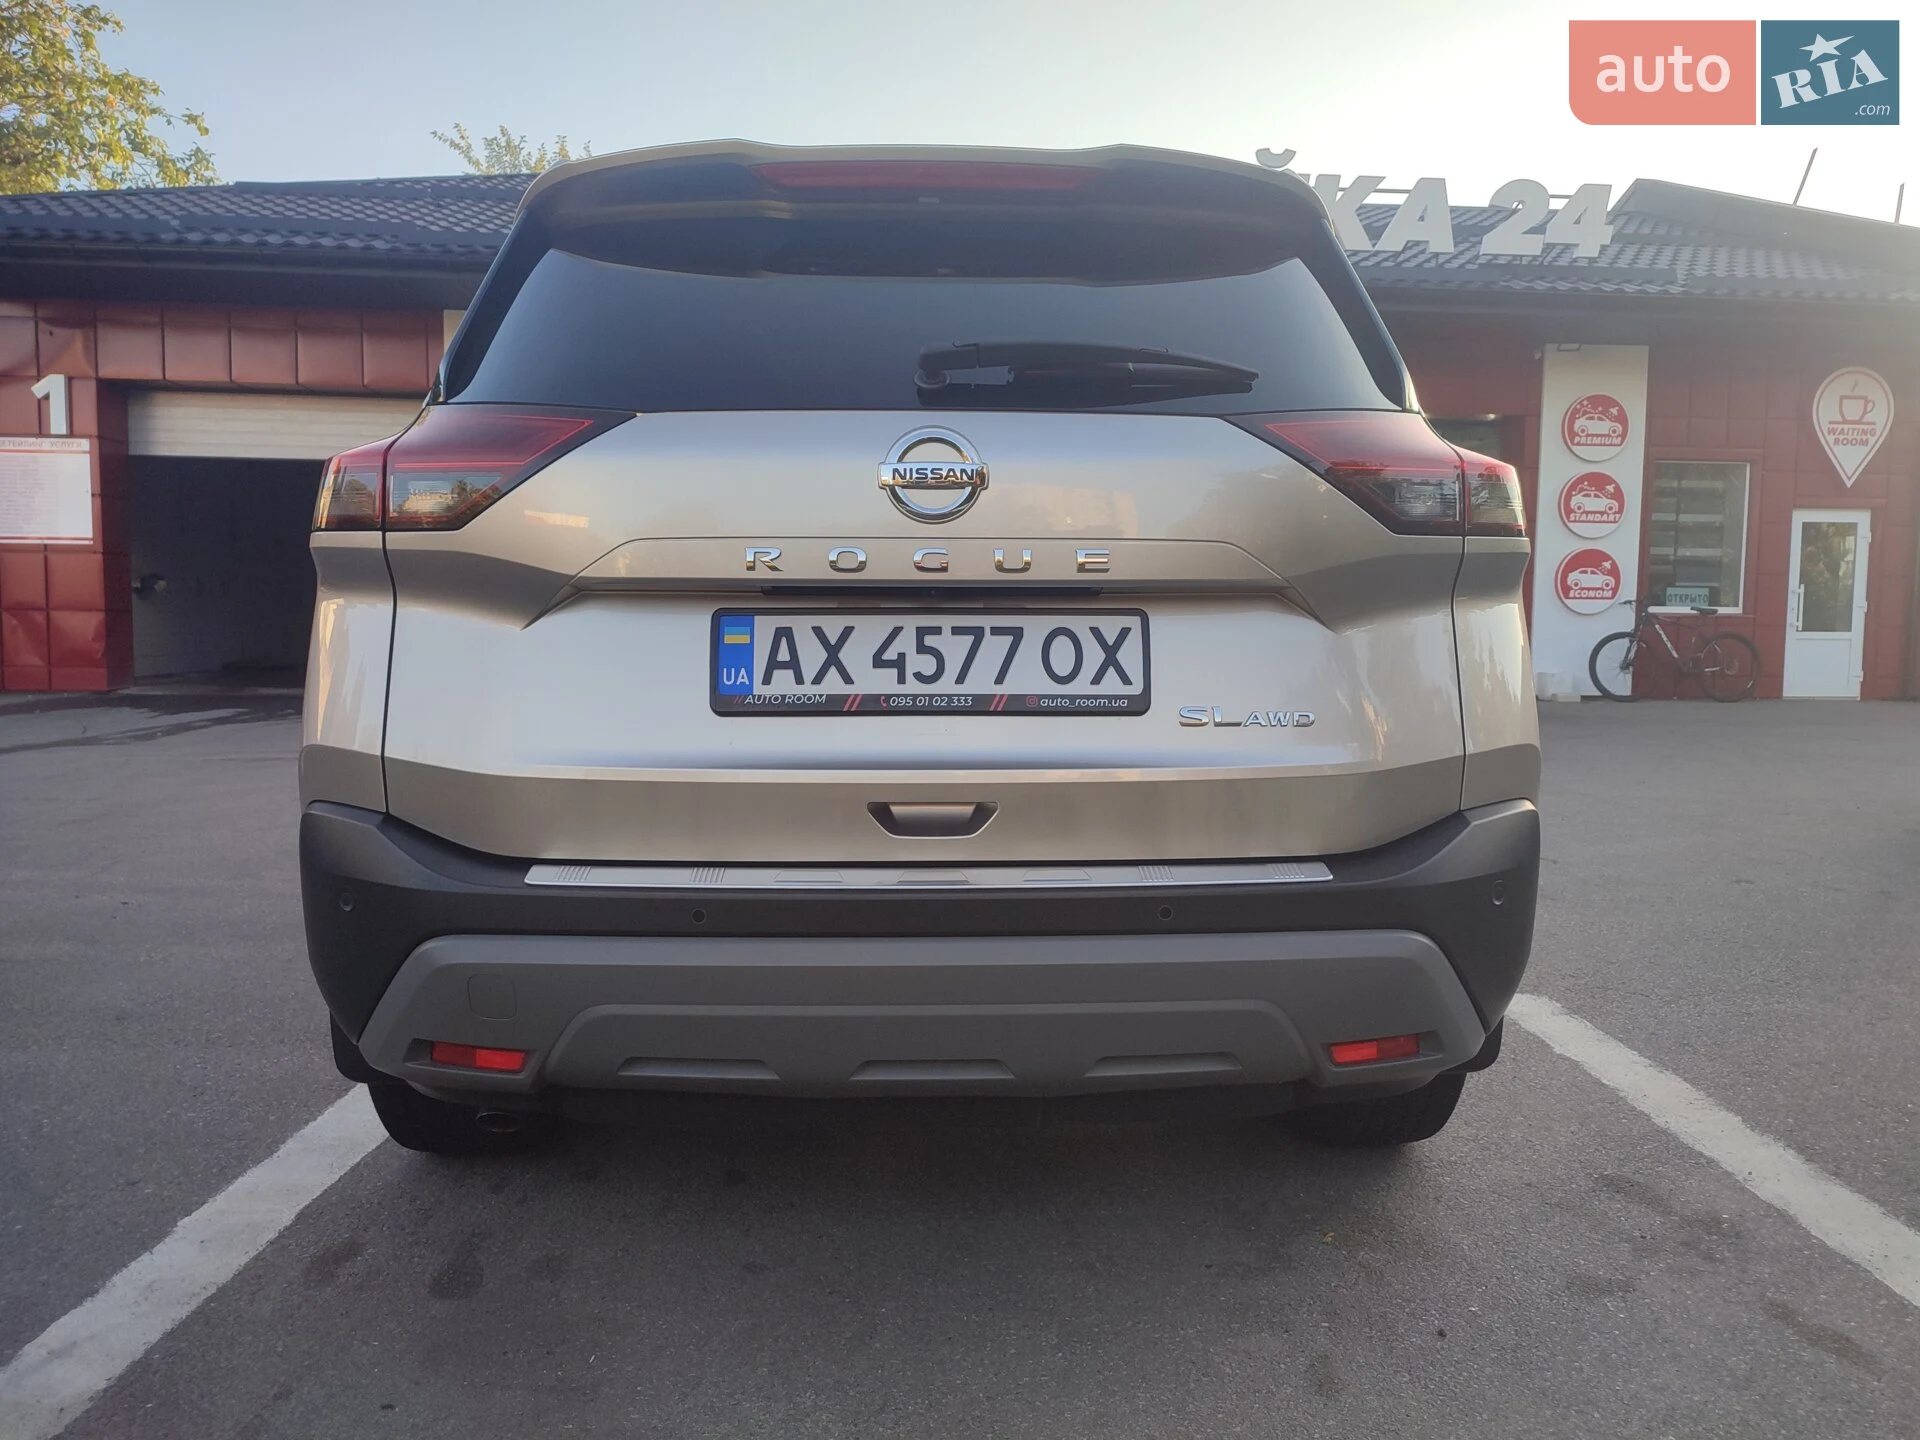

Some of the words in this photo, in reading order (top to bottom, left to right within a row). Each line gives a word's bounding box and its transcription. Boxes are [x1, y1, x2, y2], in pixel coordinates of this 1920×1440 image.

[1479, 178, 1613, 258] 24
[31, 373, 69, 435] 1
[1827, 426, 1877, 437] WAITING
[1573, 435, 1622, 445] PREMIUM
[1832, 436, 1870, 447] ROOM
[892, 466, 976, 482] NISSAN
[1569, 512, 1622, 522] STANDART
[744, 546, 1111, 574] ROGUE
[1568, 589, 1614, 599] ECONOM
[1667, 593, 1710, 604] ОТКРЫТО
[761, 626, 856, 686] AX
[872, 626, 1025, 686] 4577
[1041, 626, 1134, 686] OX
[722, 667, 750, 686] UA
[744, 693, 782, 705] AUTO
[785, 693, 827, 705] ROOM
[889, 695, 914, 707] 095
[916, 695, 930, 707] 01
[932, 695, 949, 707] 02
[950, 695, 973, 707] 333
[1039, 696, 1129, 708] auto_room.ua
